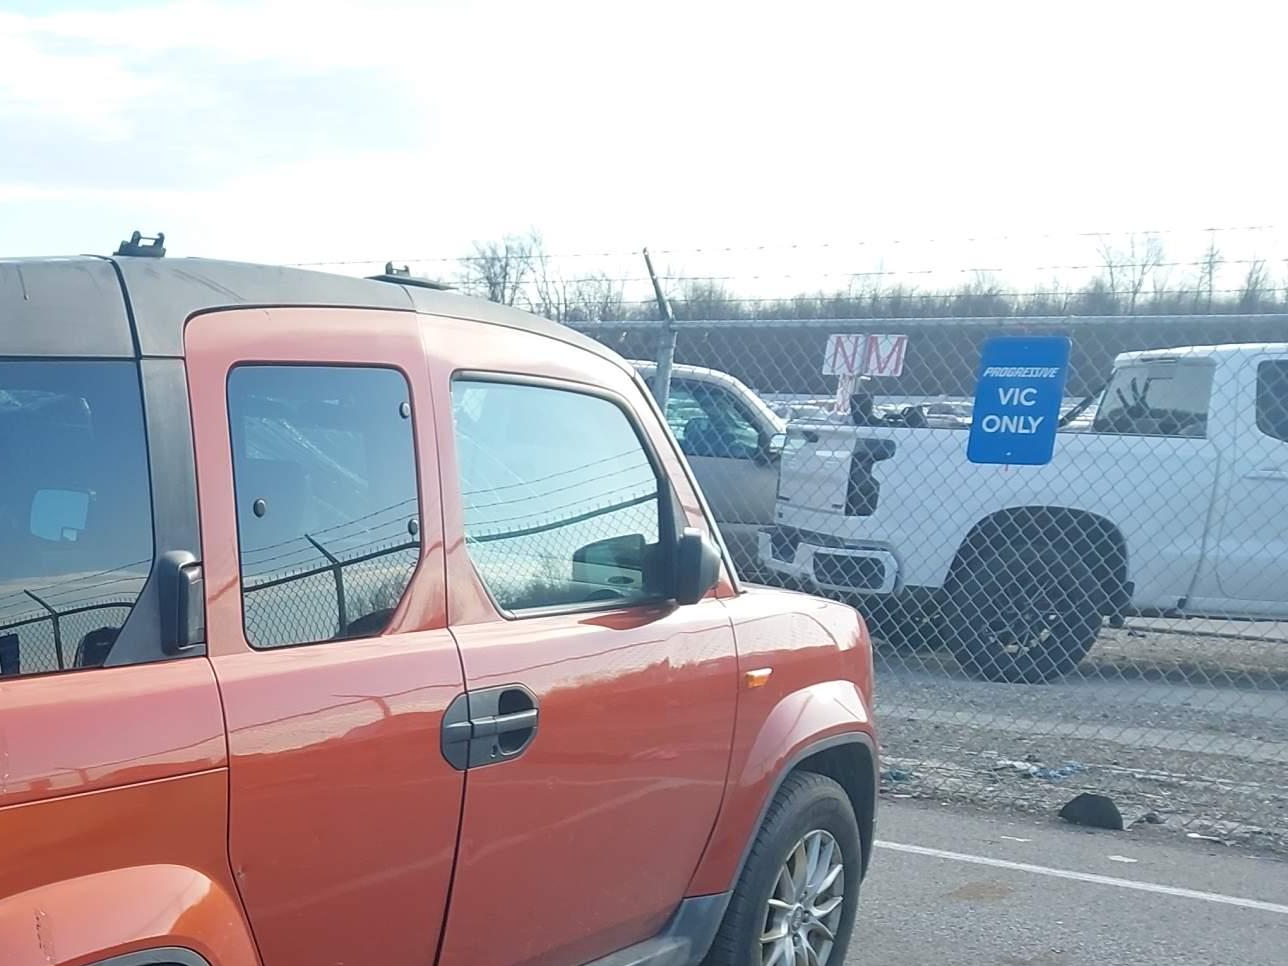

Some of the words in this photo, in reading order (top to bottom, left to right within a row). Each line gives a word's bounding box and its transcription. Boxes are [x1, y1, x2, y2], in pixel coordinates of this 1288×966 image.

[983, 366, 1060, 378] PROGRESSIVE
[998, 387, 1038, 406] VIC
[982, 415, 1045, 434] ONLY
